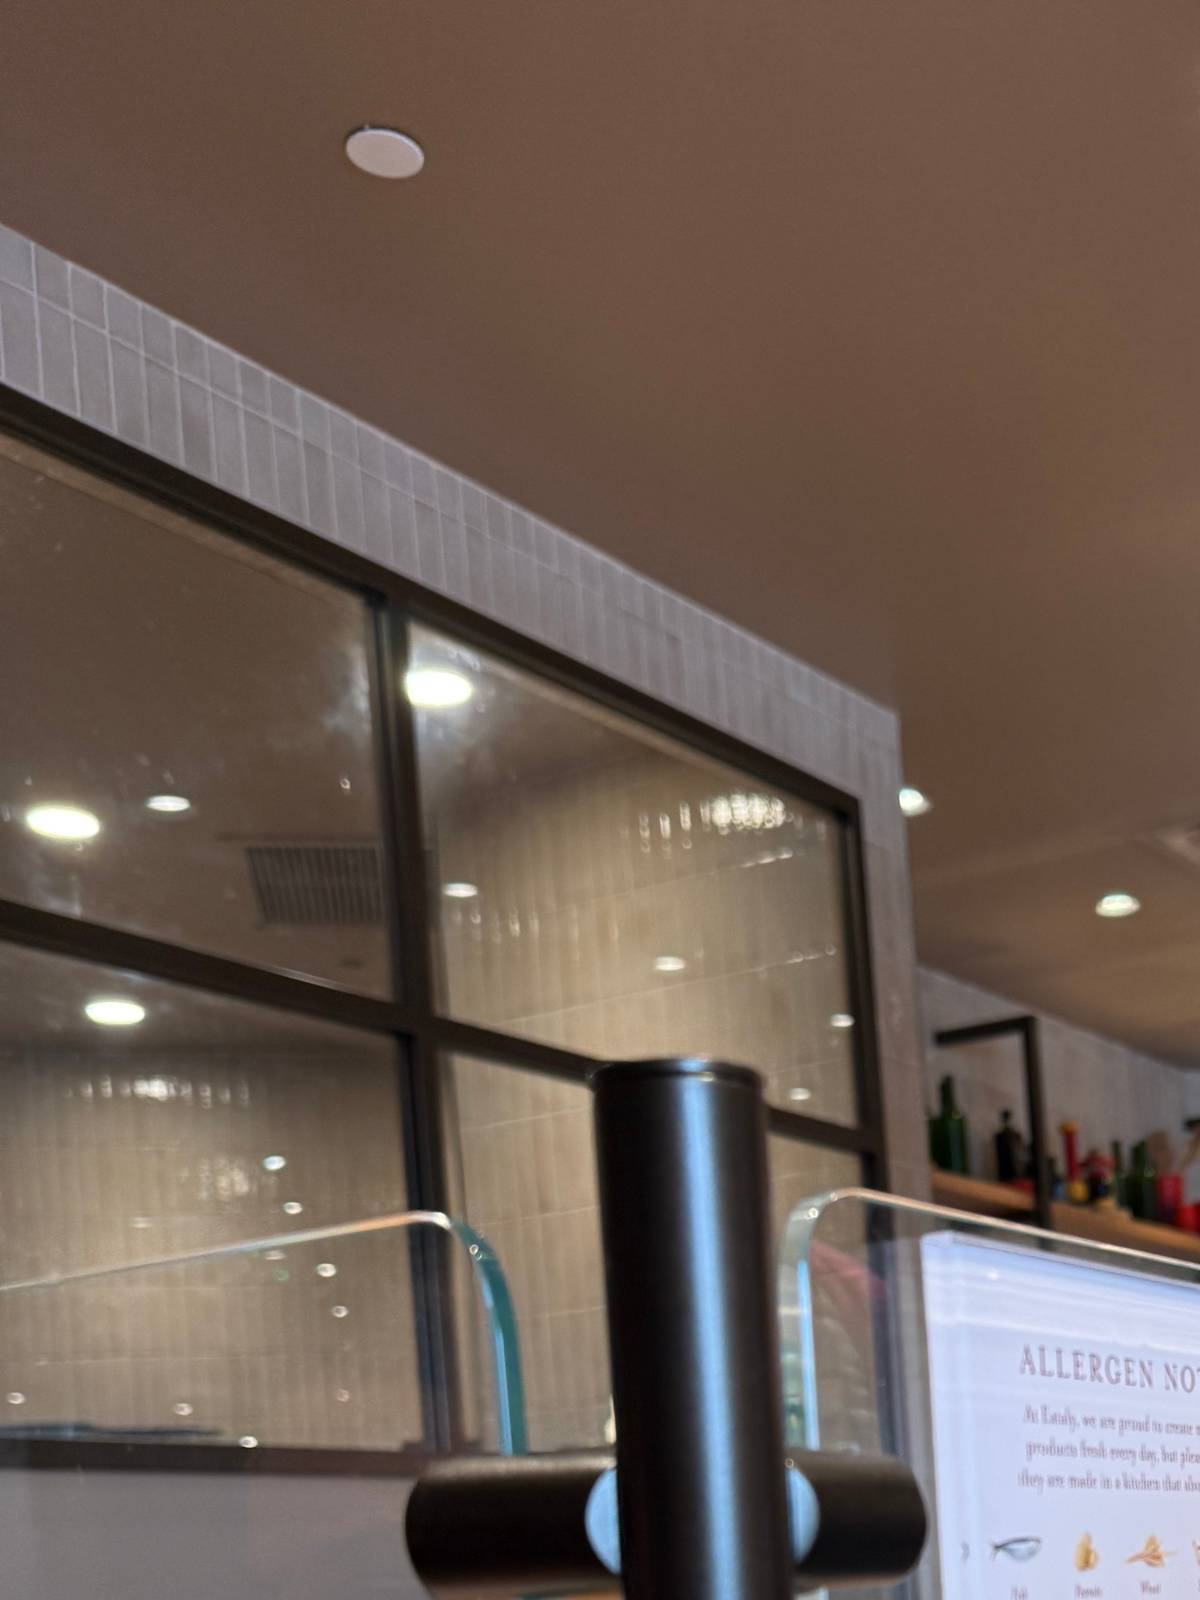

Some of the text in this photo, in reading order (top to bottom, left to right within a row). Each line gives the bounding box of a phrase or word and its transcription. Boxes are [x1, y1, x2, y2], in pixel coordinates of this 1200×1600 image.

[1019, 1344, 1153, 1390] ALLERGEN
[1118, 1414, 1150, 1436] proud
[1122, 1471, 1162, 1492] kitchen
